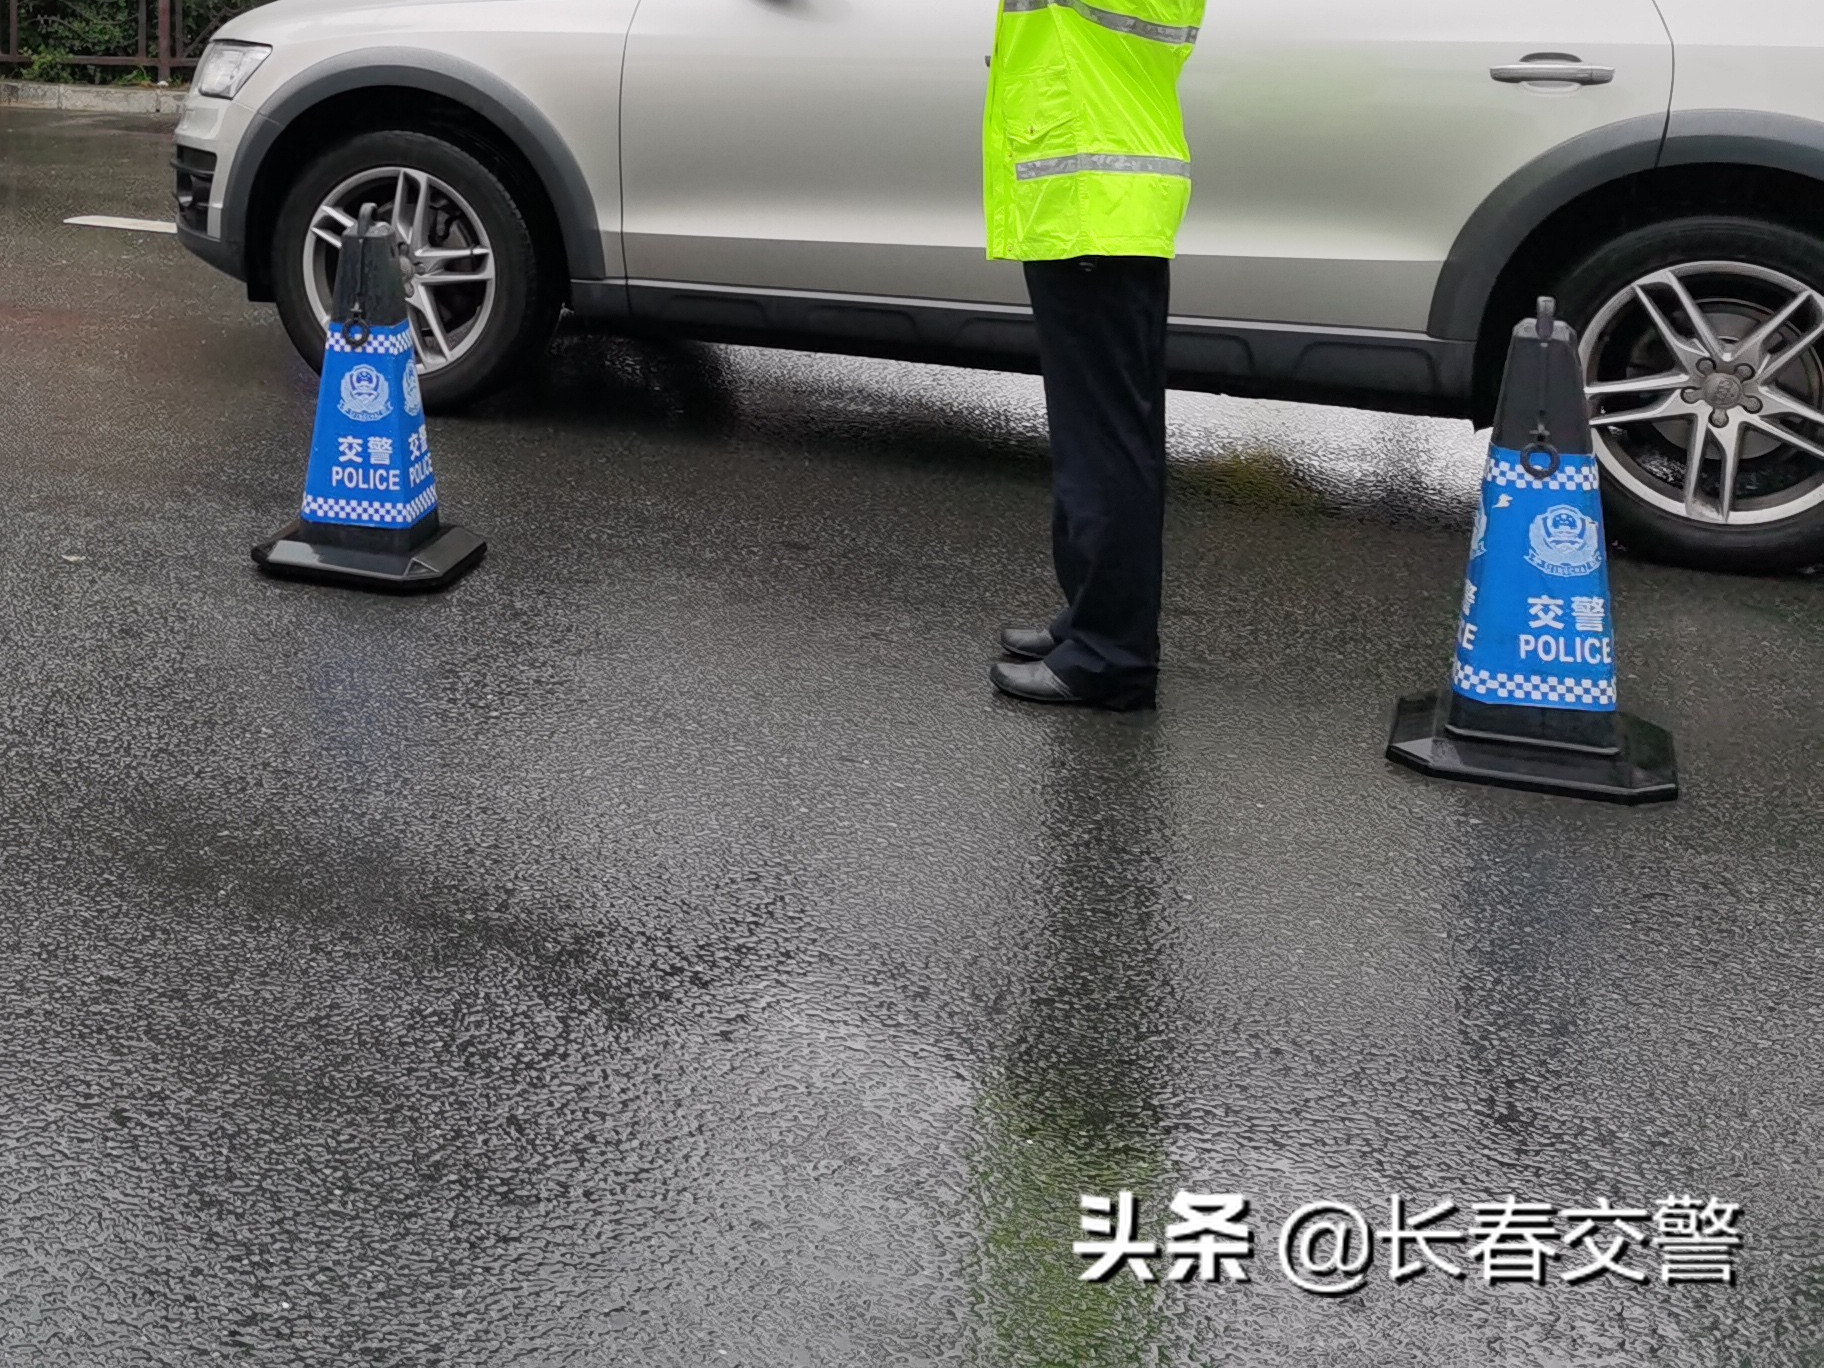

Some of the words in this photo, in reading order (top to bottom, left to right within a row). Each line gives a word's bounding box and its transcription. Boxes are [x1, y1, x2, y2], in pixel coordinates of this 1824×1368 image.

[338, 435, 393, 465] 交警
[332, 466, 401, 491] POLICE
[1527, 594, 1605, 632] 交警
[1519, 634, 1612, 665] POLICE
